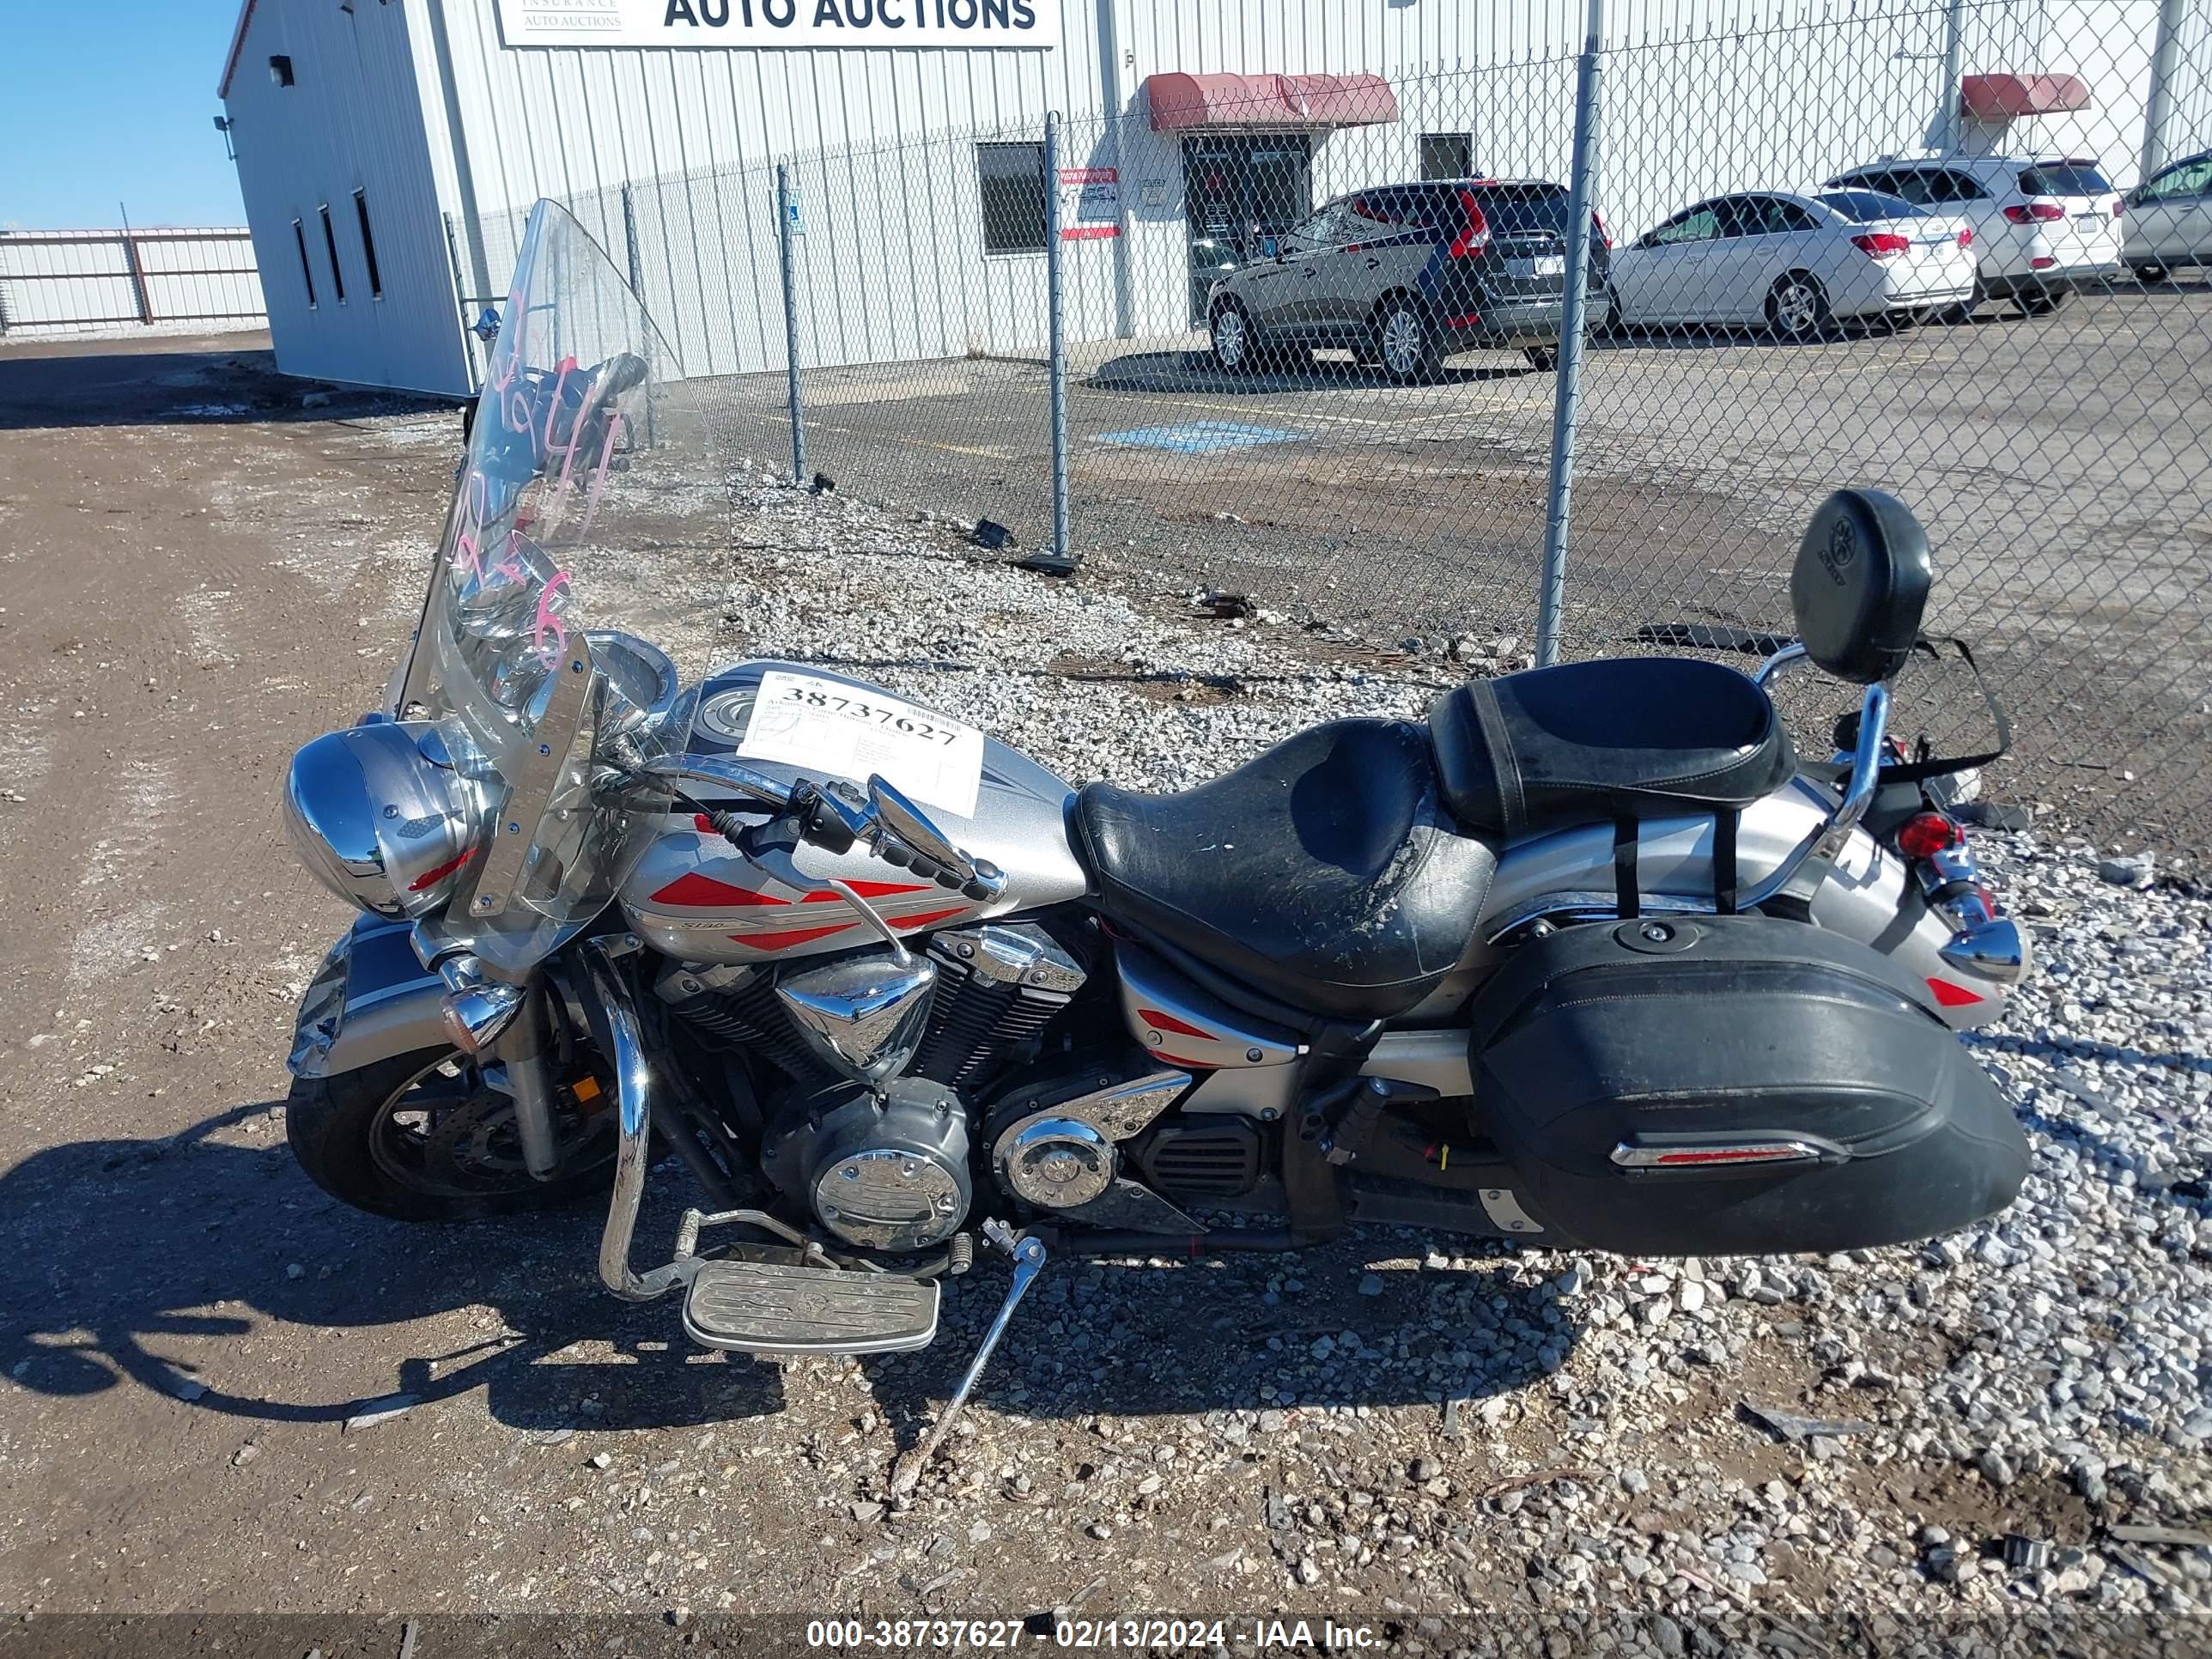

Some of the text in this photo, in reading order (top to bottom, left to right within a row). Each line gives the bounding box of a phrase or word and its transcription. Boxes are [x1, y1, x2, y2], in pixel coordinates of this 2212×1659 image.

[524, 15, 622, 27] AUTO AUCTIONS
[664, 0, 1036, 29] AUTO AUCTIONS
[781, 686, 957, 746] 38737627
